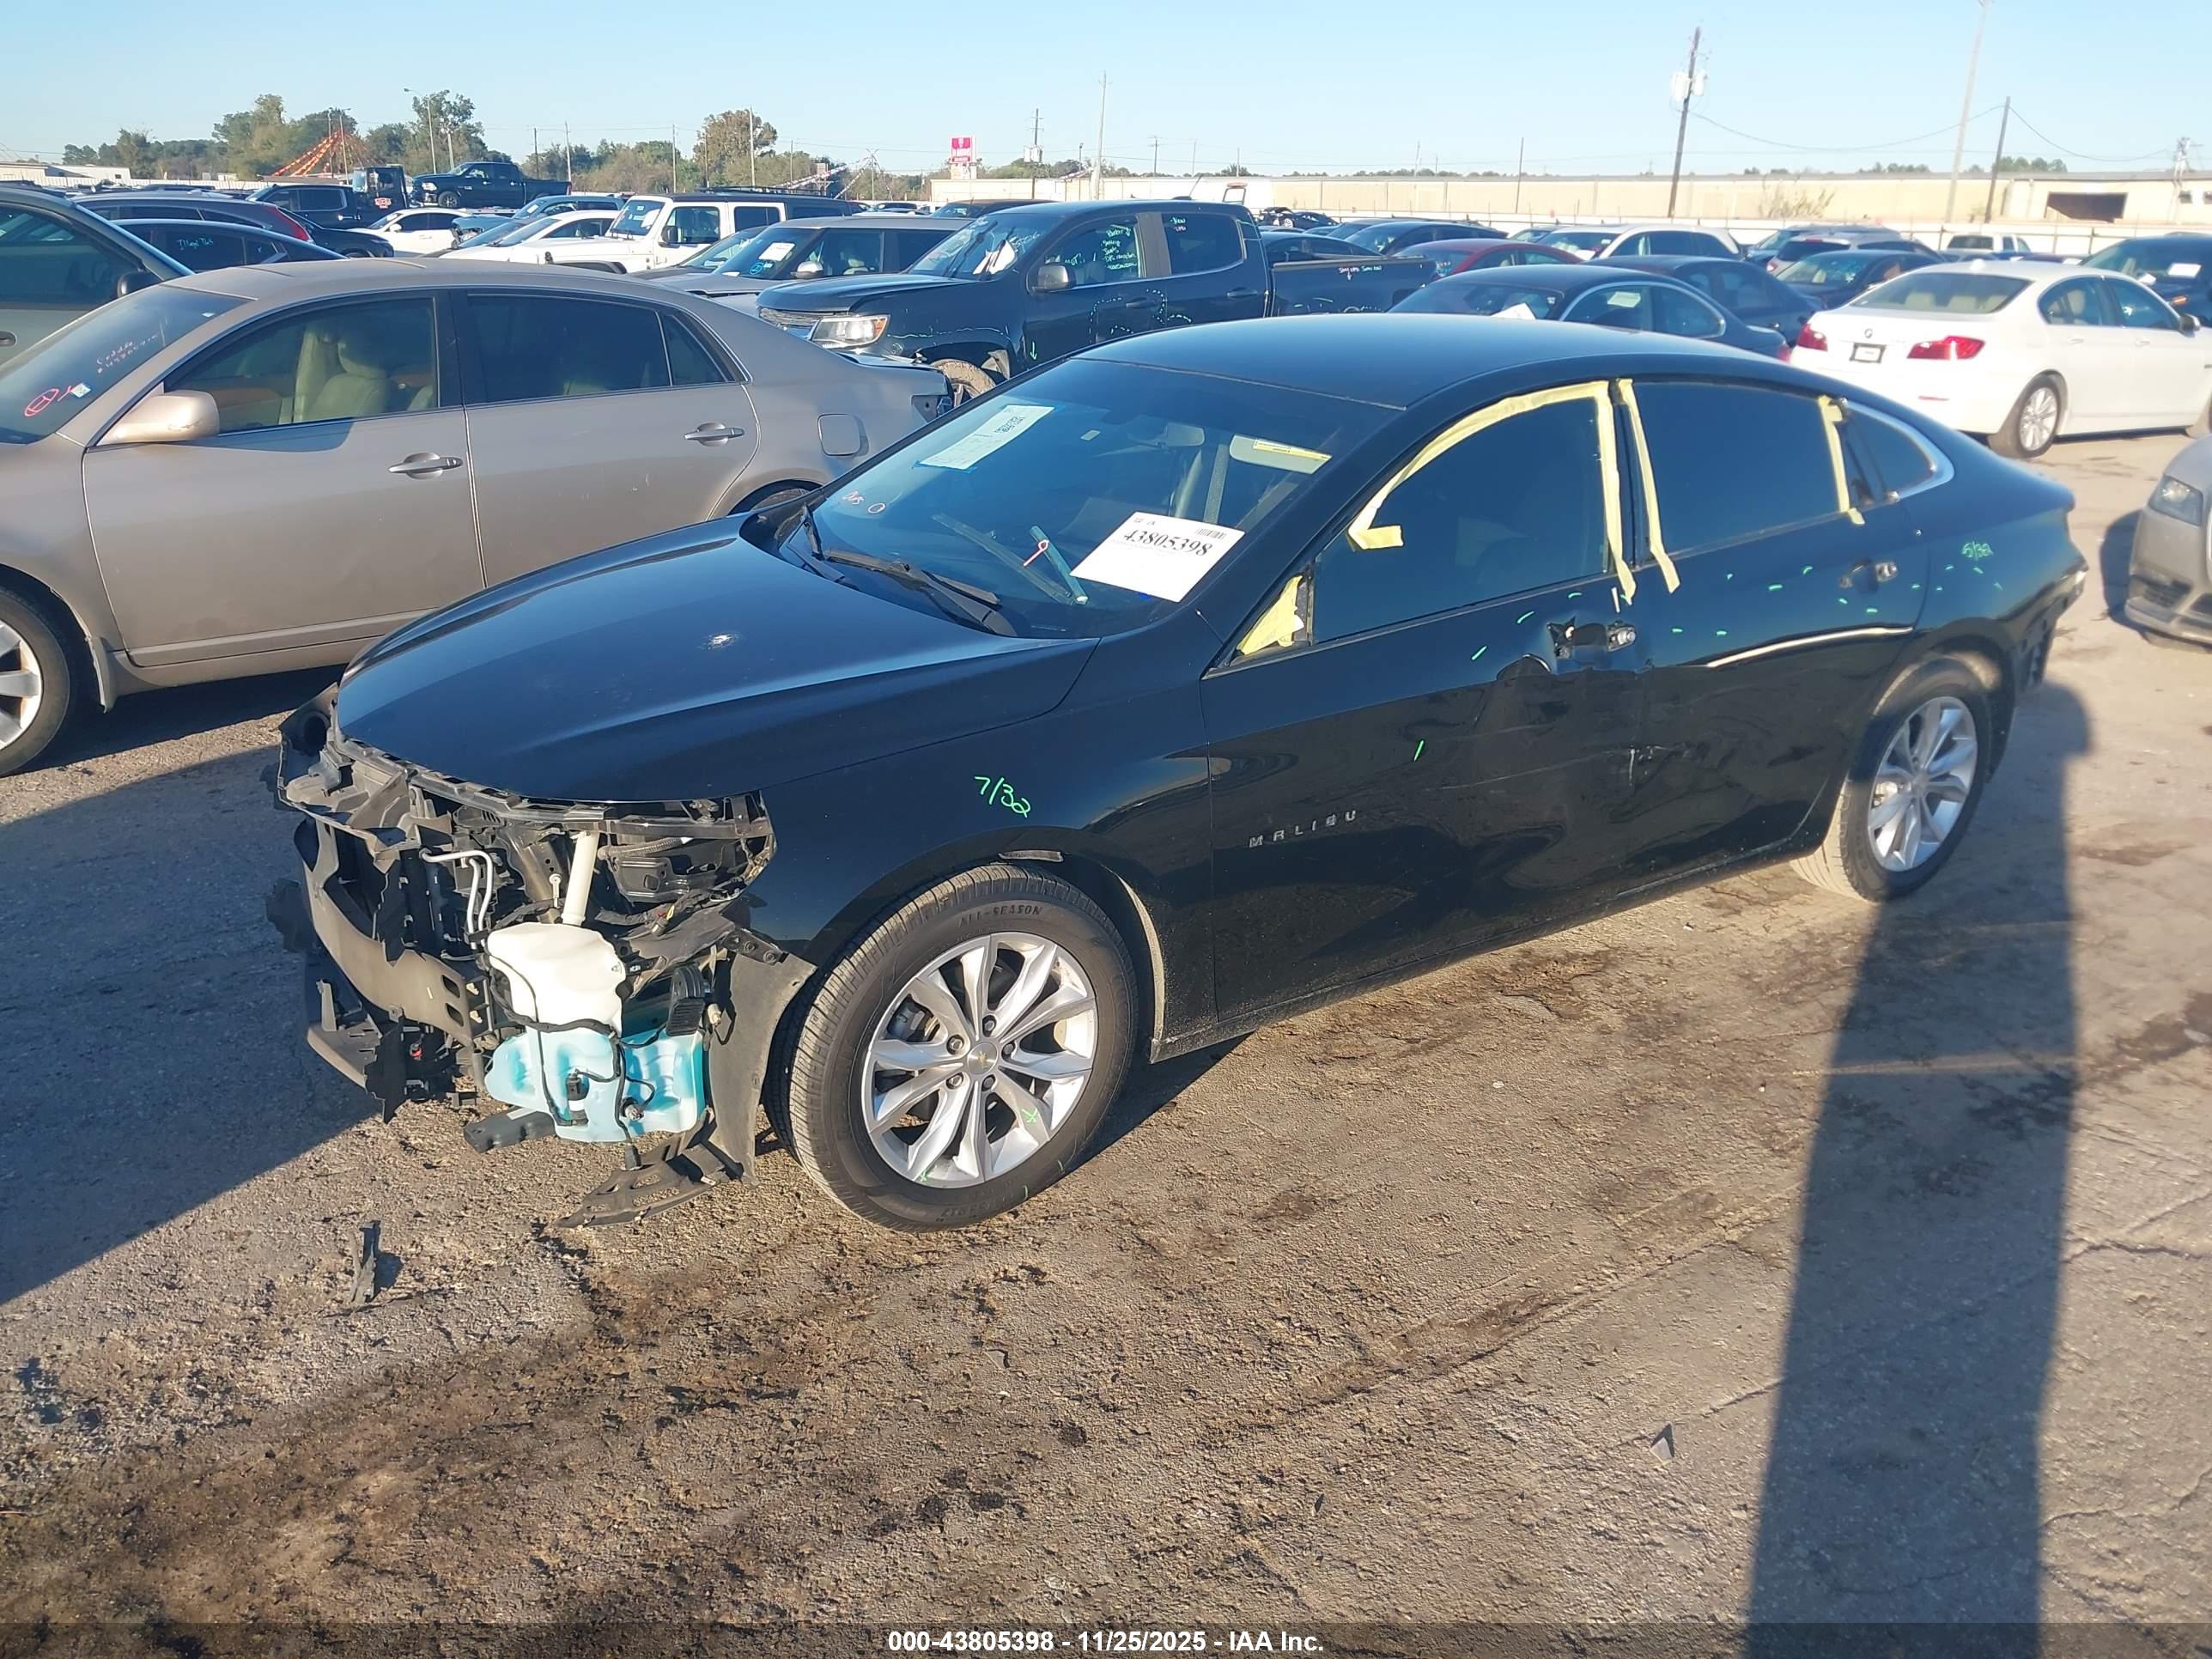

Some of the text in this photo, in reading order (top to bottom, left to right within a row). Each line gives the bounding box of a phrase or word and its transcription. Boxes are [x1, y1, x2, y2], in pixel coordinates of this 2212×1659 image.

[1123, 529, 1213, 556] 43805398
[974, 776, 1031, 818] 7/32
[1249, 810, 1357, 848] MALIBU
